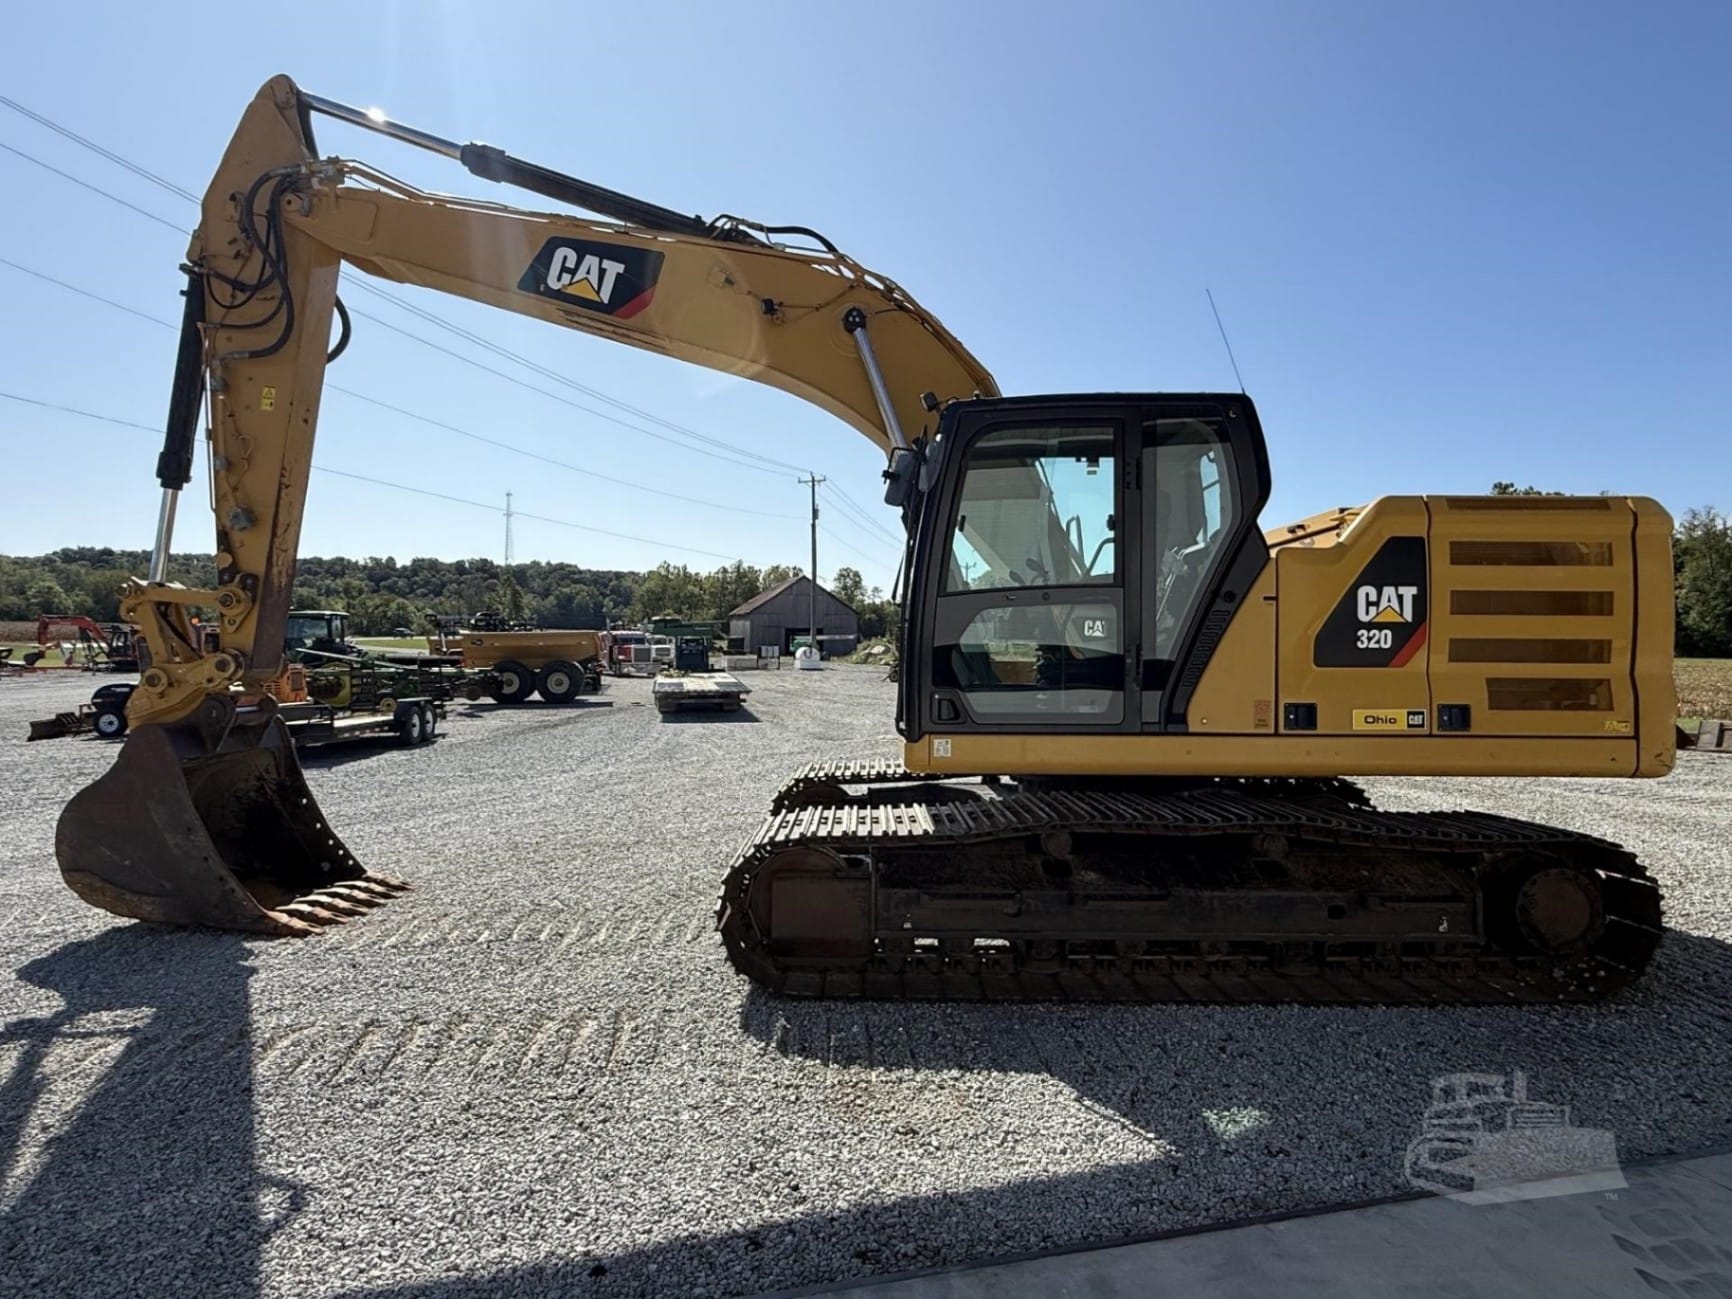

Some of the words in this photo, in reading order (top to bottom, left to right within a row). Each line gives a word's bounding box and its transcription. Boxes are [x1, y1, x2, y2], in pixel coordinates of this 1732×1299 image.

[547, 246, 625, 304] CAT
[1357, 585, 1417, 622] CAT
[1084, 620, 1105, 636] CA
[1356, 629, 1392, 648] 320
[1364, 715, 1397, 724] Ohio
[1408, 714, 1424, 725] CAT
